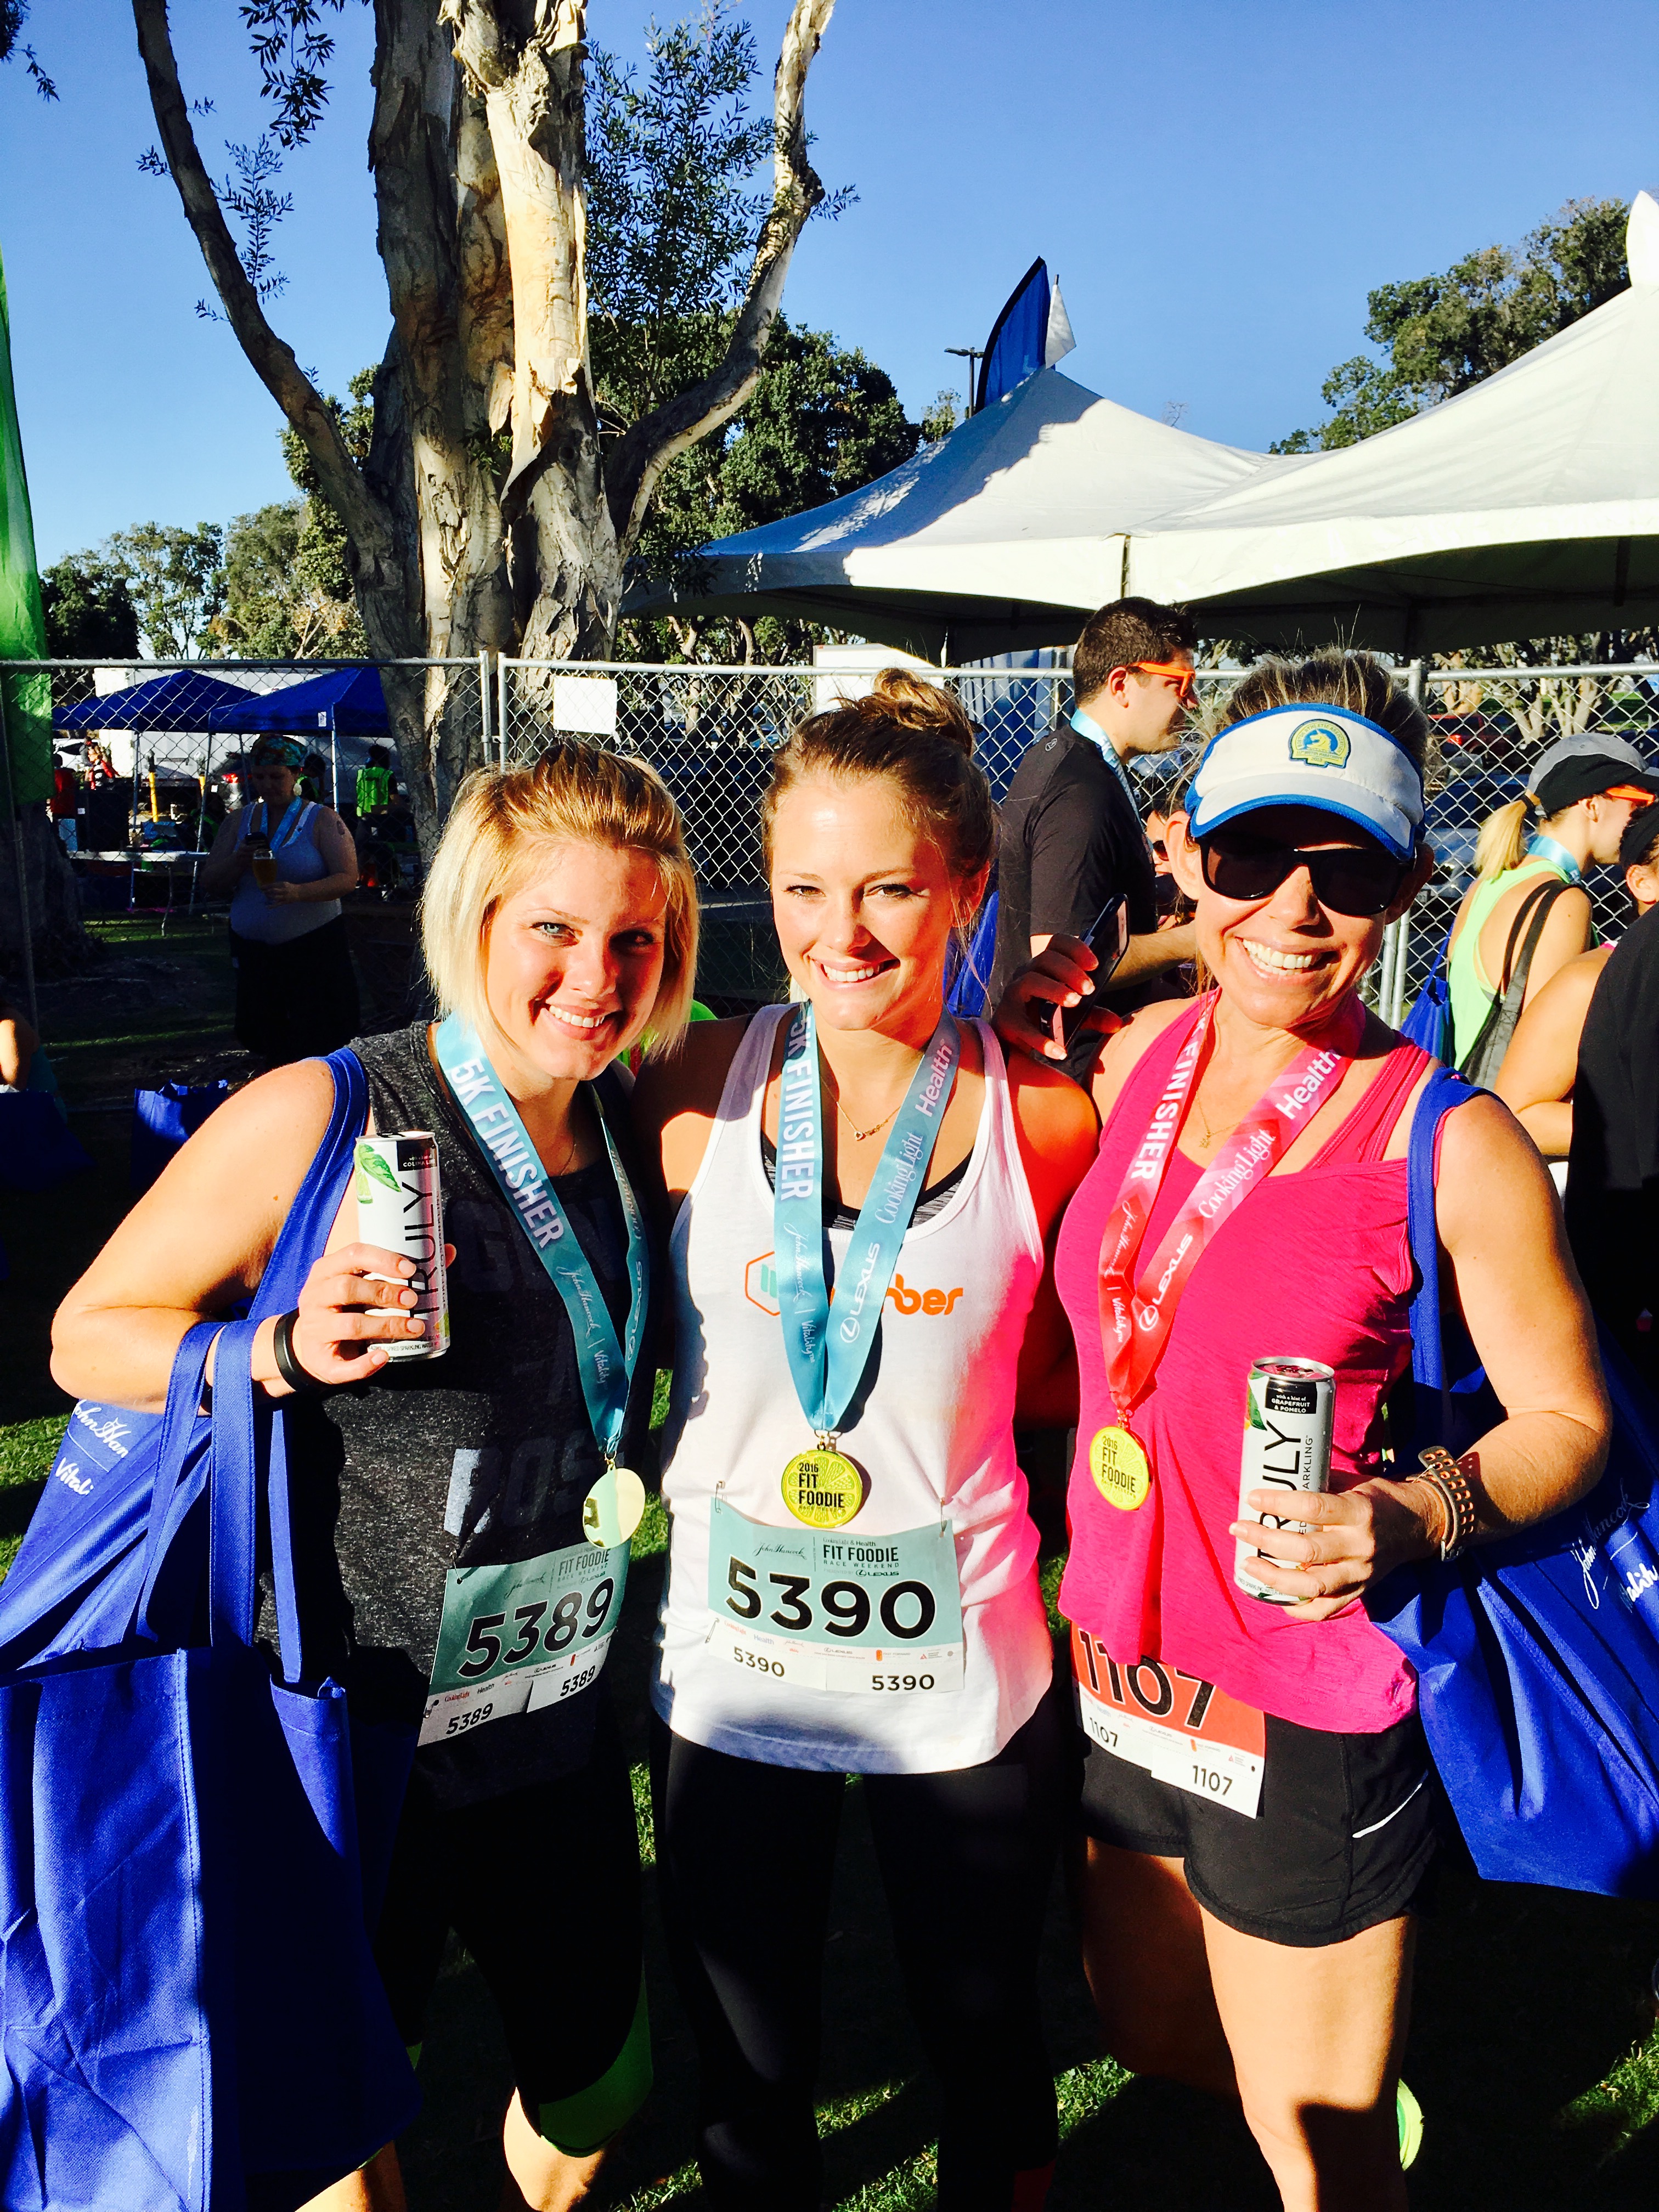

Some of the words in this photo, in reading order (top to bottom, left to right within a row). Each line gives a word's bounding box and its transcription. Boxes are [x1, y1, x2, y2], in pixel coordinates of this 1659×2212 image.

[788, 1015, 811, 1057] 5K
[451, 1058, 495, 1106] 5K
[915, 1043, 953, 1118] Health
[1275, 1048, 1341, 1120] Health
[1131, 1041, 1199, 1179] FINISHER
[781, 1059, 814, 1201] FINISHER
[472, 1102, 565, 1249] FINISHER
[850, 1242, 881, 1316] LEXUS
[1153, 1233, 1193, 1305] LEXUS
[1271, 1398, 1310, 1407] GRAPEFRUIT
[1103, 1436, 1118, 1450] 2016
[1103, 1447, 1117, 1466] FIT
[799, 1463, 819, 1472] 2016
[799, 1473, 819, 1488] FIT
[1102, 1464, 1136, 1493] FOODIE
[799, 1490, 845, 1508] FOODIE
[558, 1558, 575, 1576] FIT
[576, 1549, 611, 1571] FOODIE
[823, 1544, 843, 1560] FIT
[848, 1547, 899, 1562] FOODIE
[726, 1554, 936, 1640] 5390
[458, 1578, 615, 1678] 5389
[754, 1634, 775, 1645] Health
[733, 1646, 785, 1677] 5390
[477, 1683, 494, 1694] Health
[560, 1665, 595, 1697] 5389
[872, 1674, 934, 1691] 5390
[1077, 1628, 1216, 1730] 1107
[446, 1703, 493, 1735] 5389
[1089, 1717, 1118, 1747] 1107
[1193, 1765, 1233, 1796] 1107
